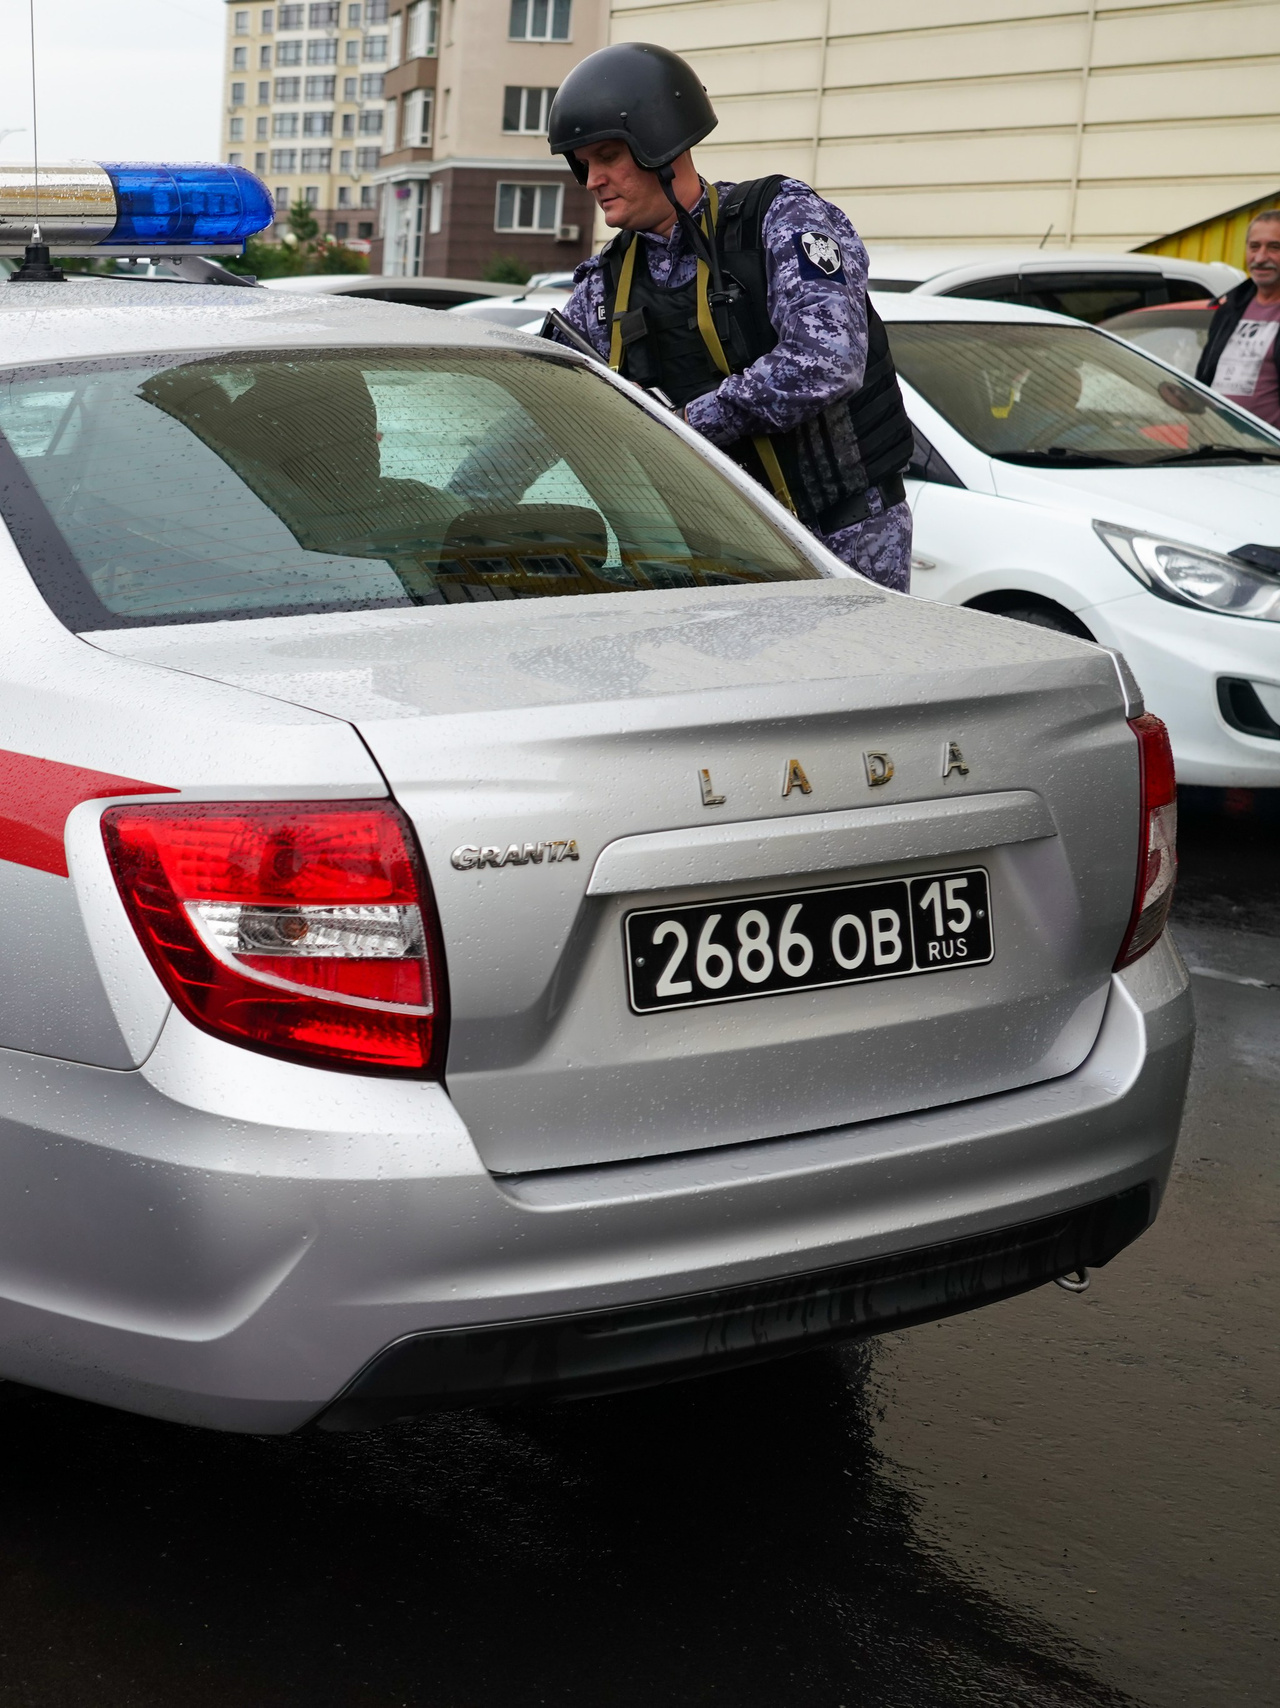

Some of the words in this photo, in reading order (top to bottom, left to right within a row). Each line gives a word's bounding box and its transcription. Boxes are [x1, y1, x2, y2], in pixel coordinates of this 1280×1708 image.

[698, 741, 969, 806] LADA
[450, 839, 580, 871] GRANTA
[651, 903, 815, 998] 2686
[919, 877, 972, 937] 15
[927, 937, 968, 961] RUS
